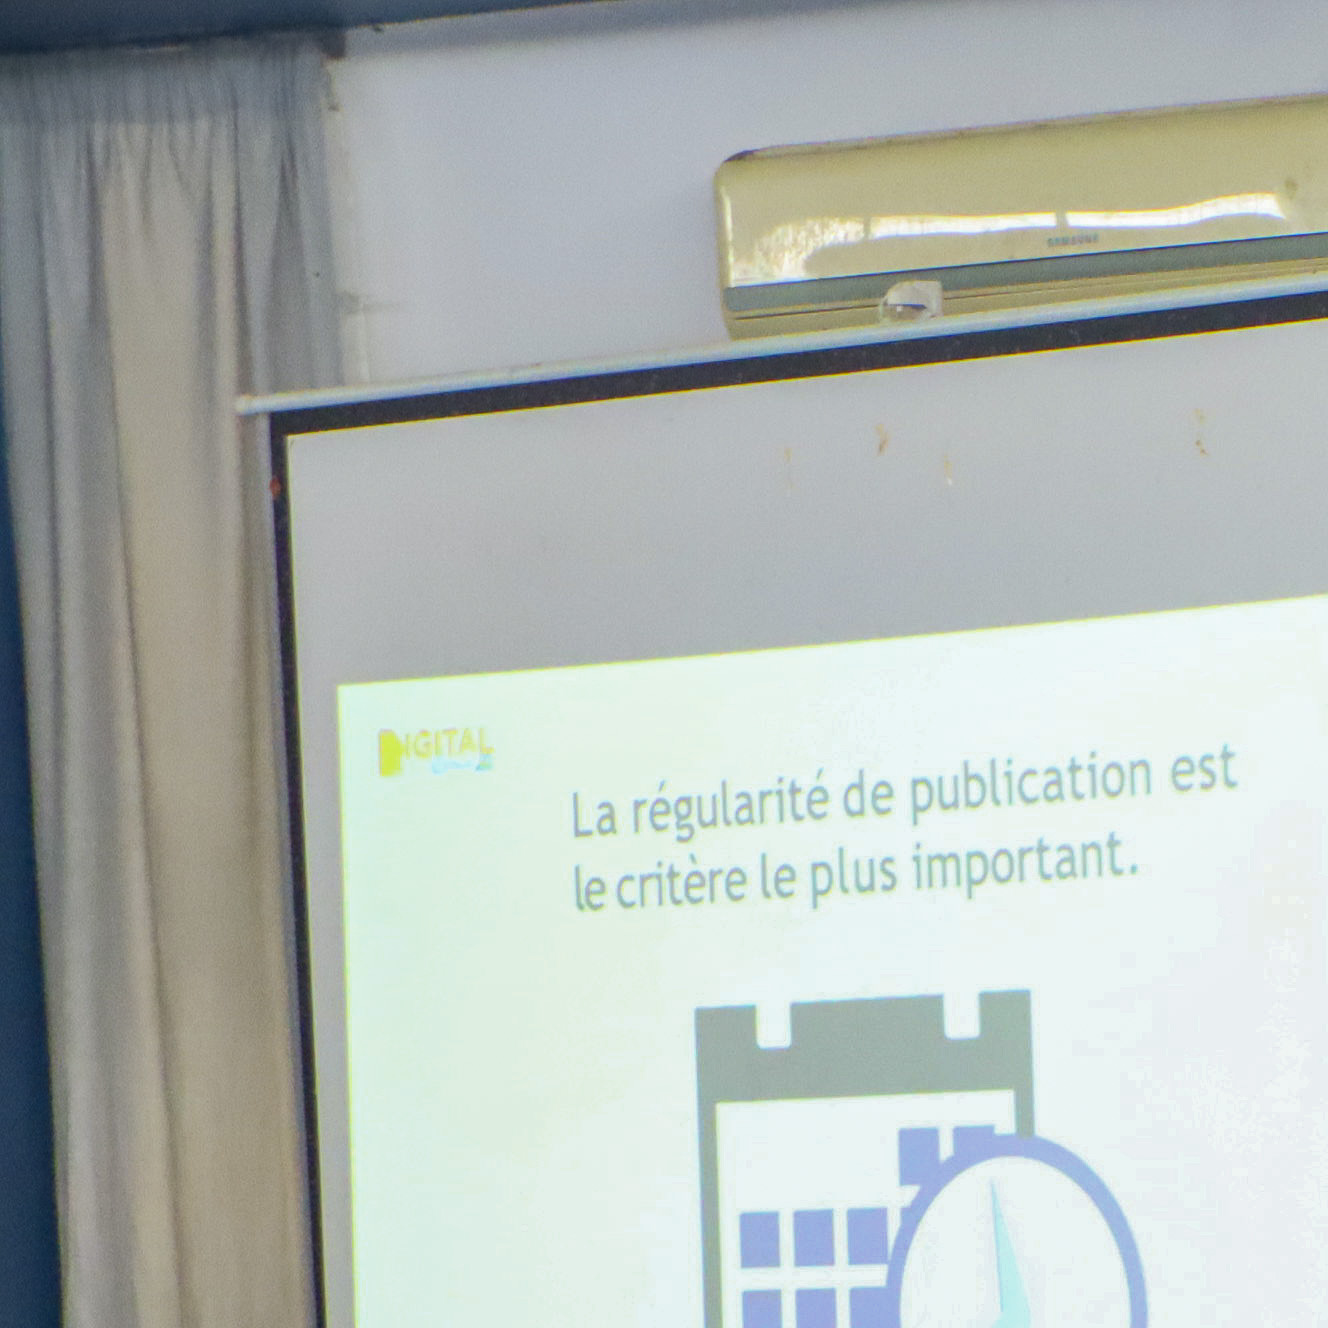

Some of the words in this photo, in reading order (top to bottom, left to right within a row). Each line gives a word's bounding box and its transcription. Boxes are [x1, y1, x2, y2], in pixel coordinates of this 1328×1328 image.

[379, 727, 496, 778] DIGITAL
[572, 790, 617, 838] La
[632, 768, 831, 843] régularité
[843, 768, 894, 817] de
[910, 750, 1152, 826] publication
[1171, 742, 1239, 792] est
[573, 865, 606, 912] le
[617, 855, 748, 910] critère
[760, 852, 797, 899] le
[811, 845, 897, 910] plus
[912, 831, 1140, 899] important.
